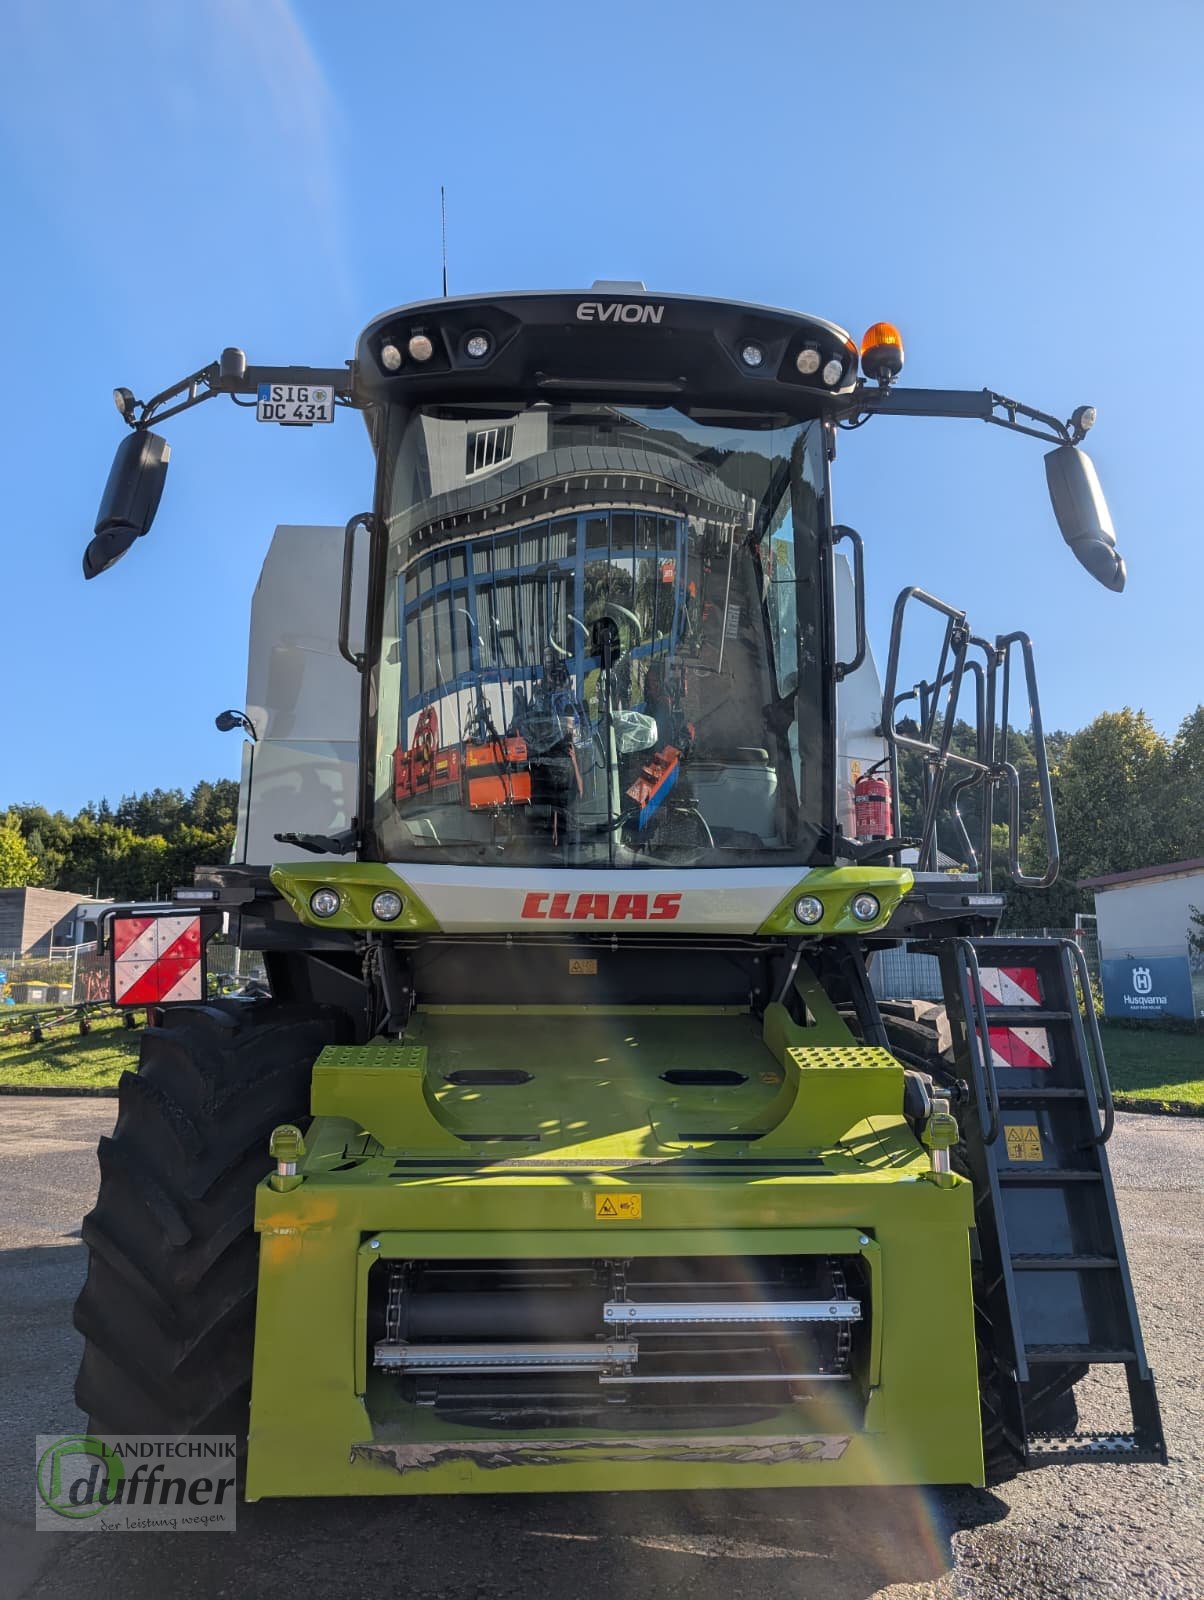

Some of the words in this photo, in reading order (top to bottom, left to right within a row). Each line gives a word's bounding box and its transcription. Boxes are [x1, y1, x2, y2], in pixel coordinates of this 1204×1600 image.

[576, 302, 664, 323] EVION
[272, 387, 309, 403] SIG
[262, 404, 286, 420] DC
[293, 405, 327, 420] 431
[521, 893, 683, 920] CLAAS
[1123, 994, 1168, 1006] Husqvarna
